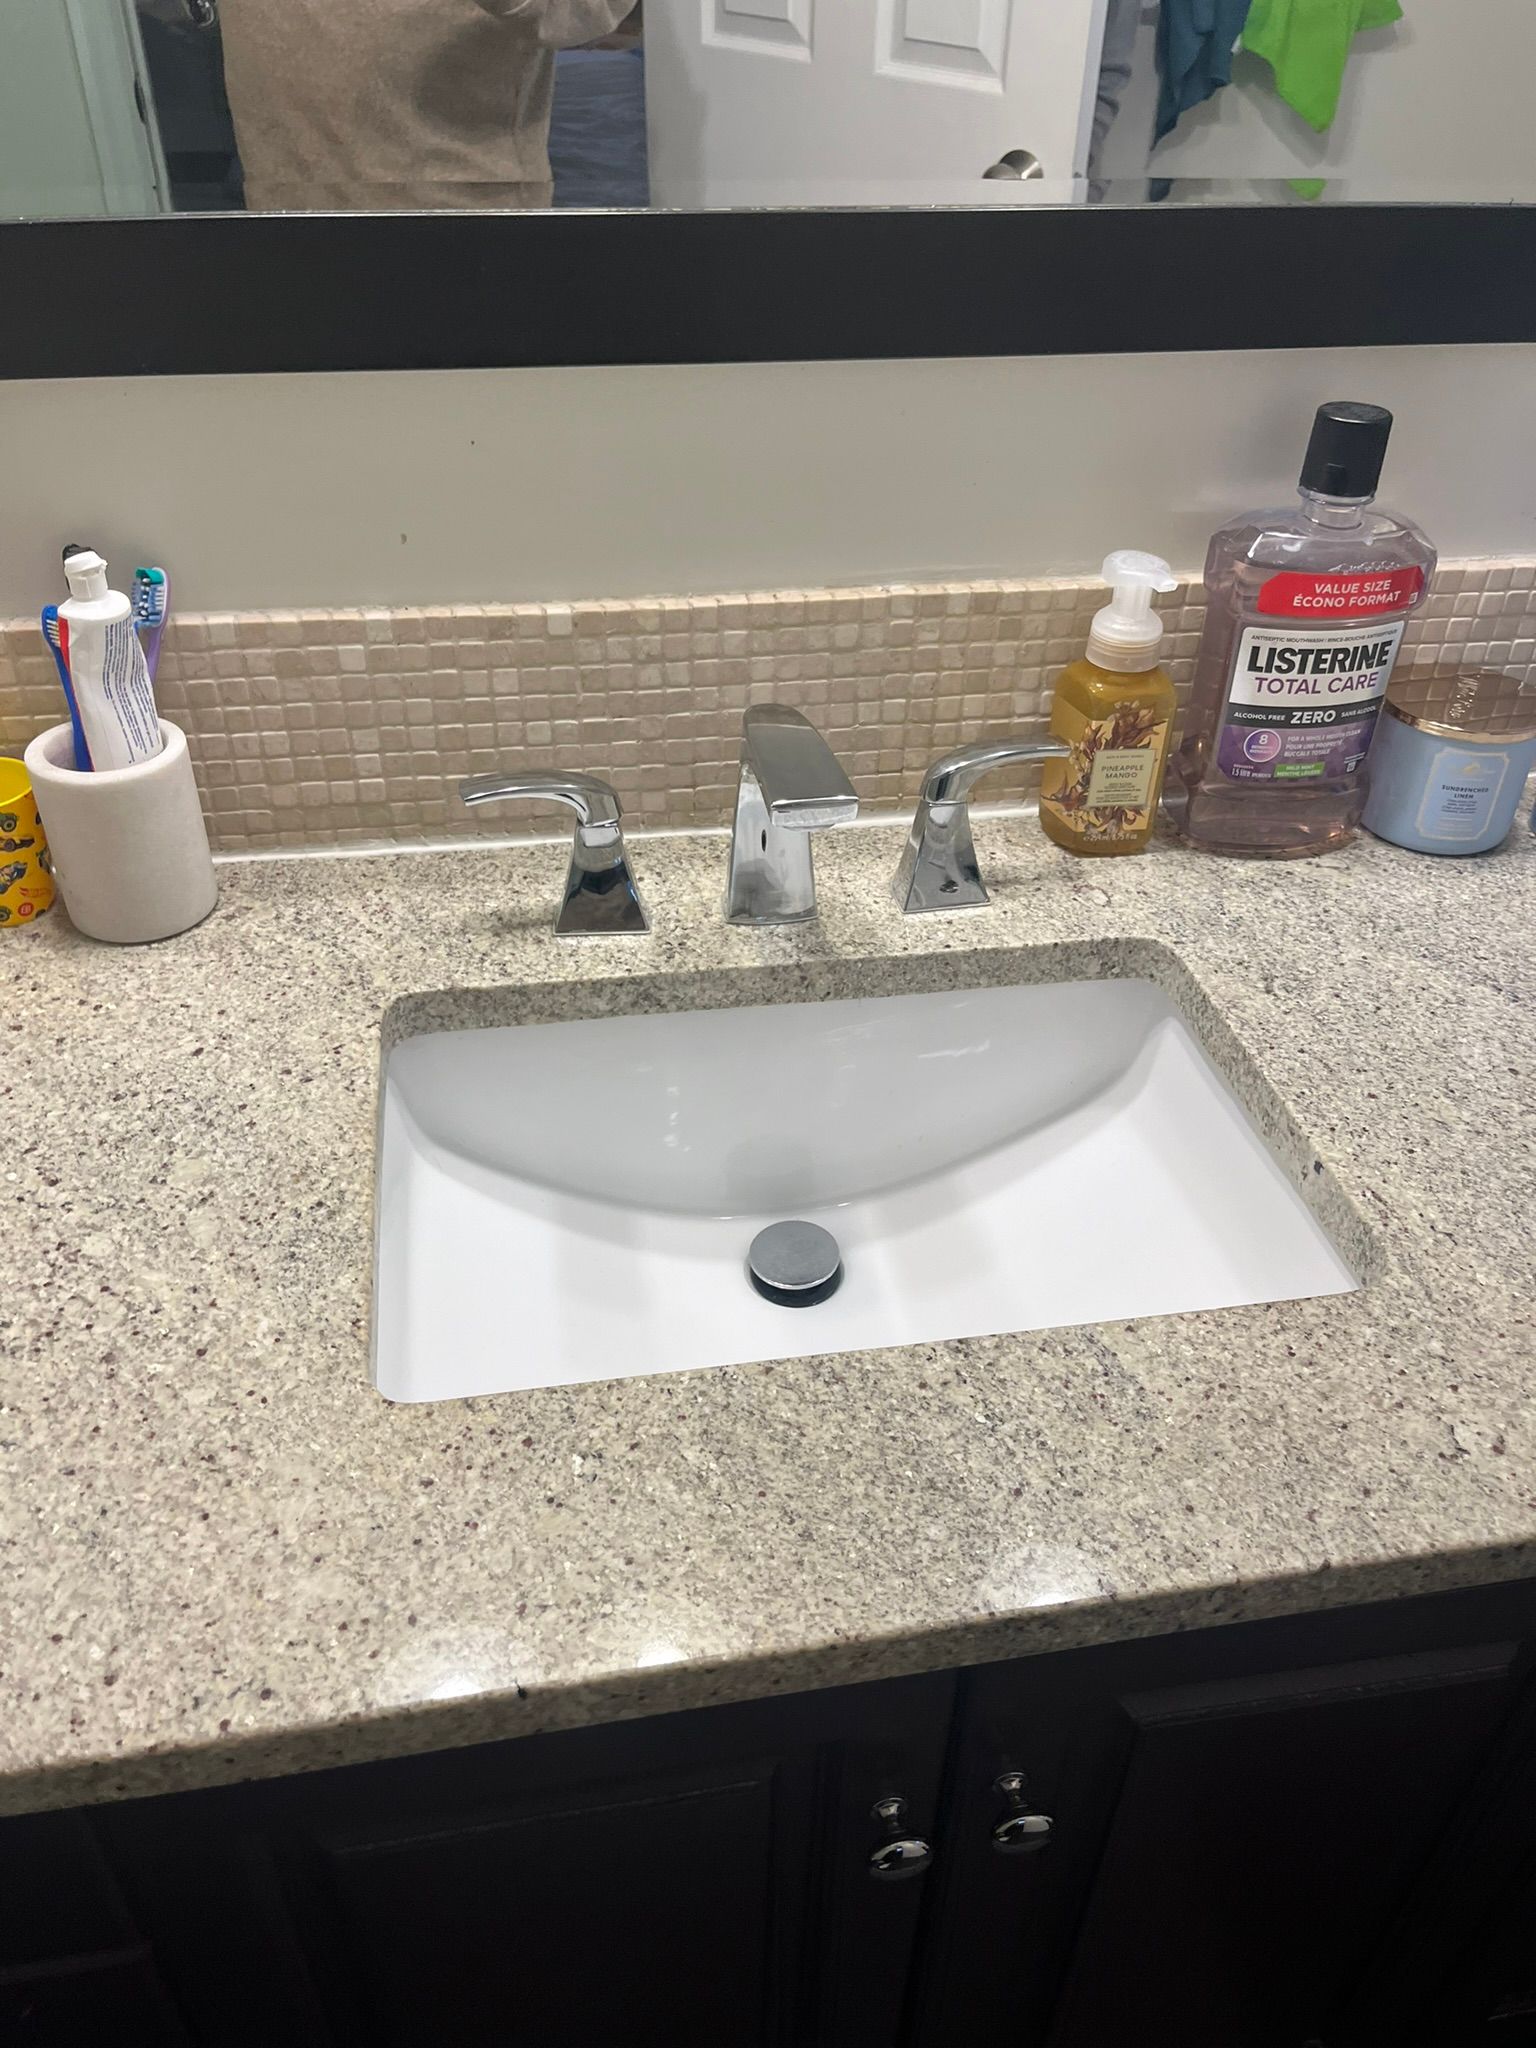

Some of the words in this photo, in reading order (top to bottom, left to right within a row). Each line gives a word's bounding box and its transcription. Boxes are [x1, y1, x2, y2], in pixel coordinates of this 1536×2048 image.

[1314, 583, 1360, 594] VALUE
[1364, 580, 1392, 592] SIZE
[1293, 594, 1345, 607] ÉCONO
[1349, 591, 1402, 606] FORMAT
[1251, 635, 1285, 643] ANTISEPTIC
[1247, 639, 1393, 675] LISTERINE
[1254, 677, 1321, 695] TOTAL
[1327, 672, 1379, 693] CARE
[1233, 712, 1267, 721] ALCOHOL
[1290, 710, 1337, 724] ZERO
[1341, 710, 1357, 718] SANS
[1258, 734, 1268, 745] 8
[1441, 784, 1489, 793] SUNDRENCHED
